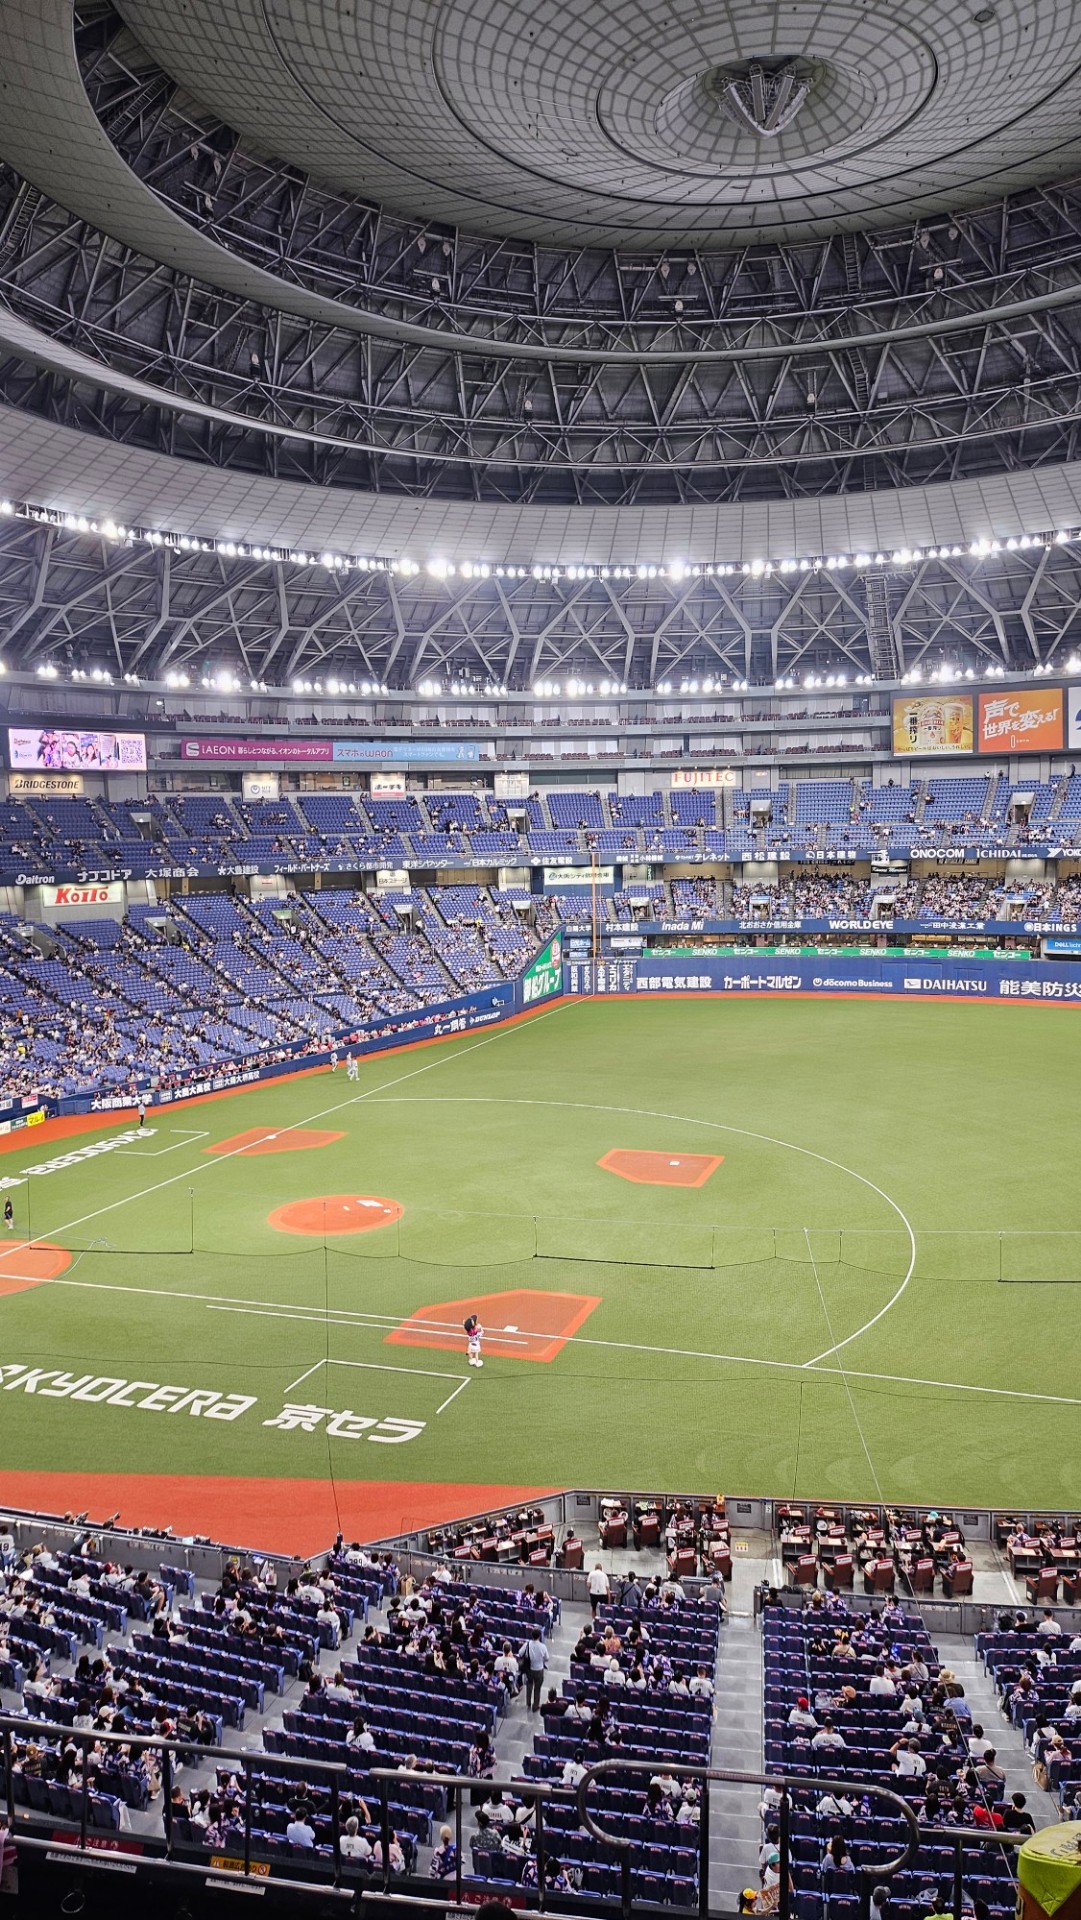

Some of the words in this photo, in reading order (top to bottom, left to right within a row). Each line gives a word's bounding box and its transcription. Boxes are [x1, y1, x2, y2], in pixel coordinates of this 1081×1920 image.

[984, 698, 1020, 724] 声で
[909, 712, 918, 743] 一番搾り
[983, 708, 1060, 739] 世界を変える!
[202, 745, 235, 755] iAEON
[337, 748, 393, 758] スマホのWAON
[675, 771, 735, 782] FUJITEC
[15, 779, 80, 790] BRIDGESTONE
[694, 853, 730, 862] テレネット
[742, 851, 791, 861] 西松建設
[910, 849, 965, 859] ONOCOM
[976, 849, 1021, 858] ICHIDAI
[145, 865, 200, 878] 大塚商会
[227, 865, 259, 875] 大豊建設
[15, 874, 55, 885] Daitron
[739, 920, 802, 930] 北おおさか信用金庫
[829, 920, 872, 930] WORLD
[873, 920, 894, 930] EYE
[1032, 922, 1078, 933] 日本INGS
[733, 948, 760, 956] センコー
[947, 950, 976, 958] SENKO
[993, 950, 1021, 958] センコー
[636, 976, 712, 989] 西部電気建設
[723, 975, 802, 990] カーポートマルゼン
[858, 979, 894, 988] Business
[923, 979, 987, 991] DAIHATSU
[91, 1093, 153, 1111] 大阪商業大学
[24, 1368, 258, 1422] KYOCERA
[262, 1403, 427, 1444] 京セラ
